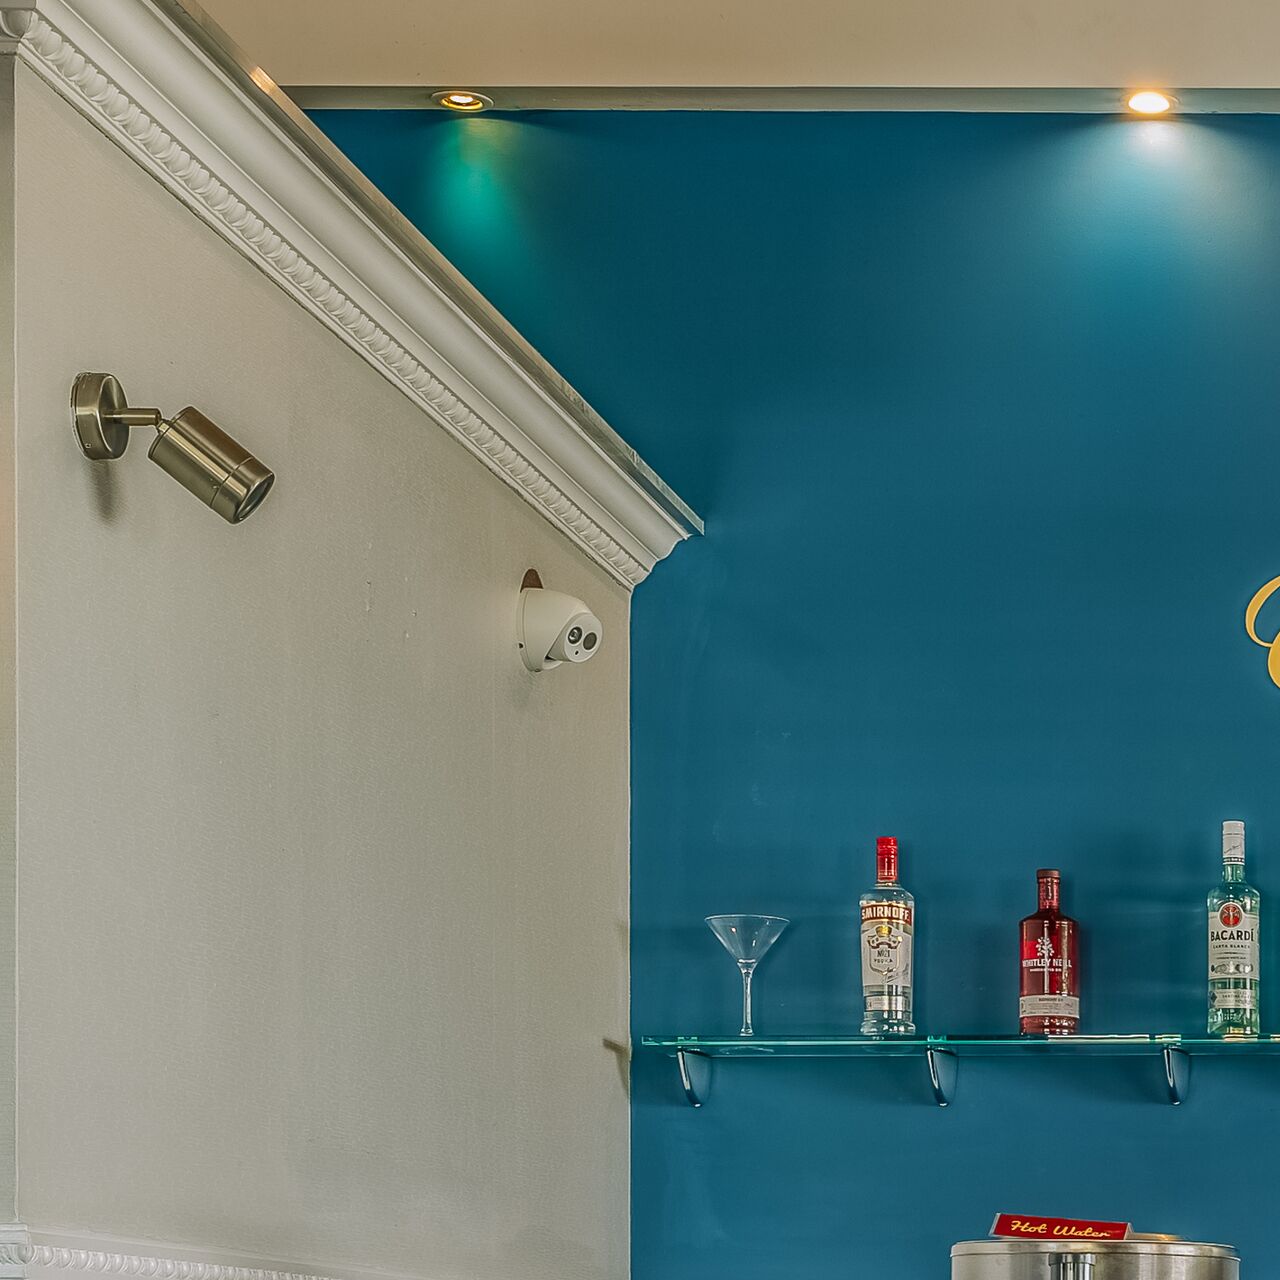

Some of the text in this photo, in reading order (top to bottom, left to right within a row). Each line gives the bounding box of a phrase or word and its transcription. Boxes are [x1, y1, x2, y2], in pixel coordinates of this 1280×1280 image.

[861, 906, 909, 920] SMIRNOFF
[1052, 958, 1073, 968] NELL
[1011, 1220, 1111, 1237] Hot Water
